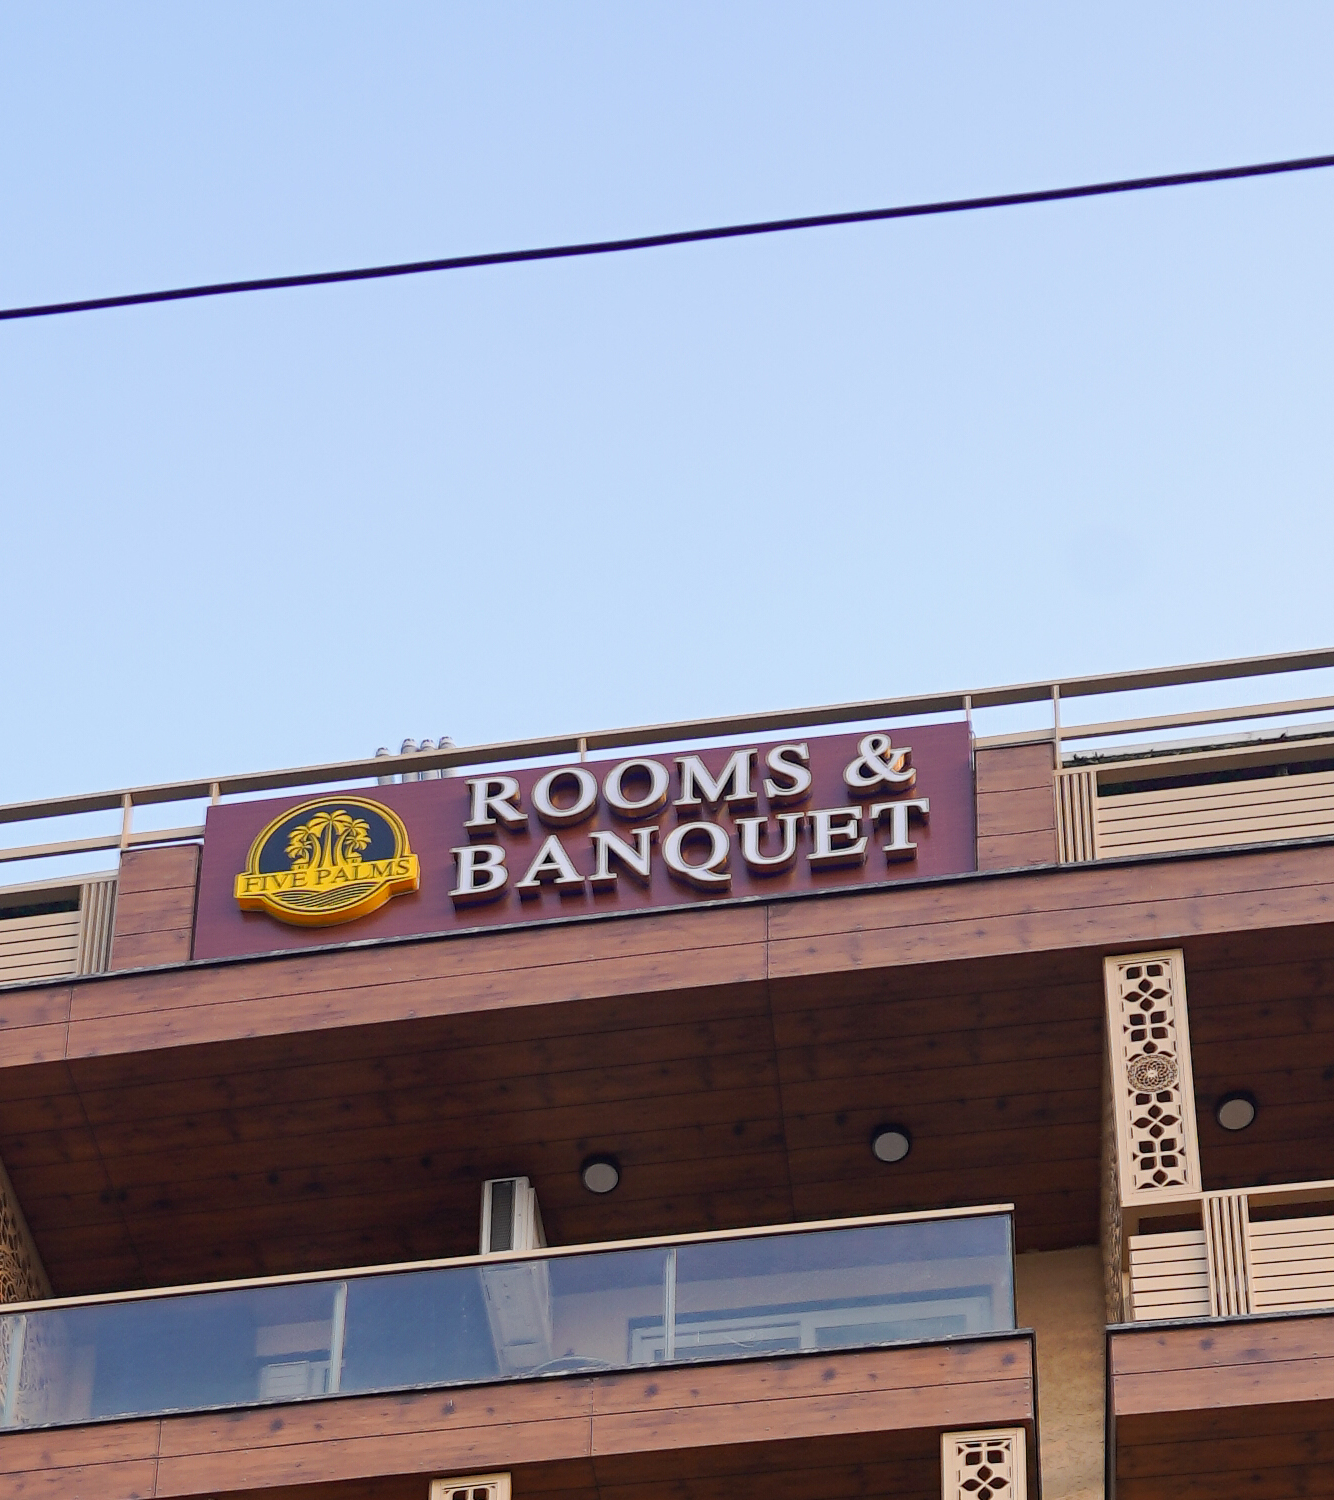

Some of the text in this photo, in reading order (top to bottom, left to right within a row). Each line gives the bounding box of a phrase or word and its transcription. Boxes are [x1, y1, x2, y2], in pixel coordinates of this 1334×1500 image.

[464, 733, 917, 827] ROOMS &
[243, 859, 410, 892] FIVE PALMS
[447, 797, 930, 897] BANQUET
